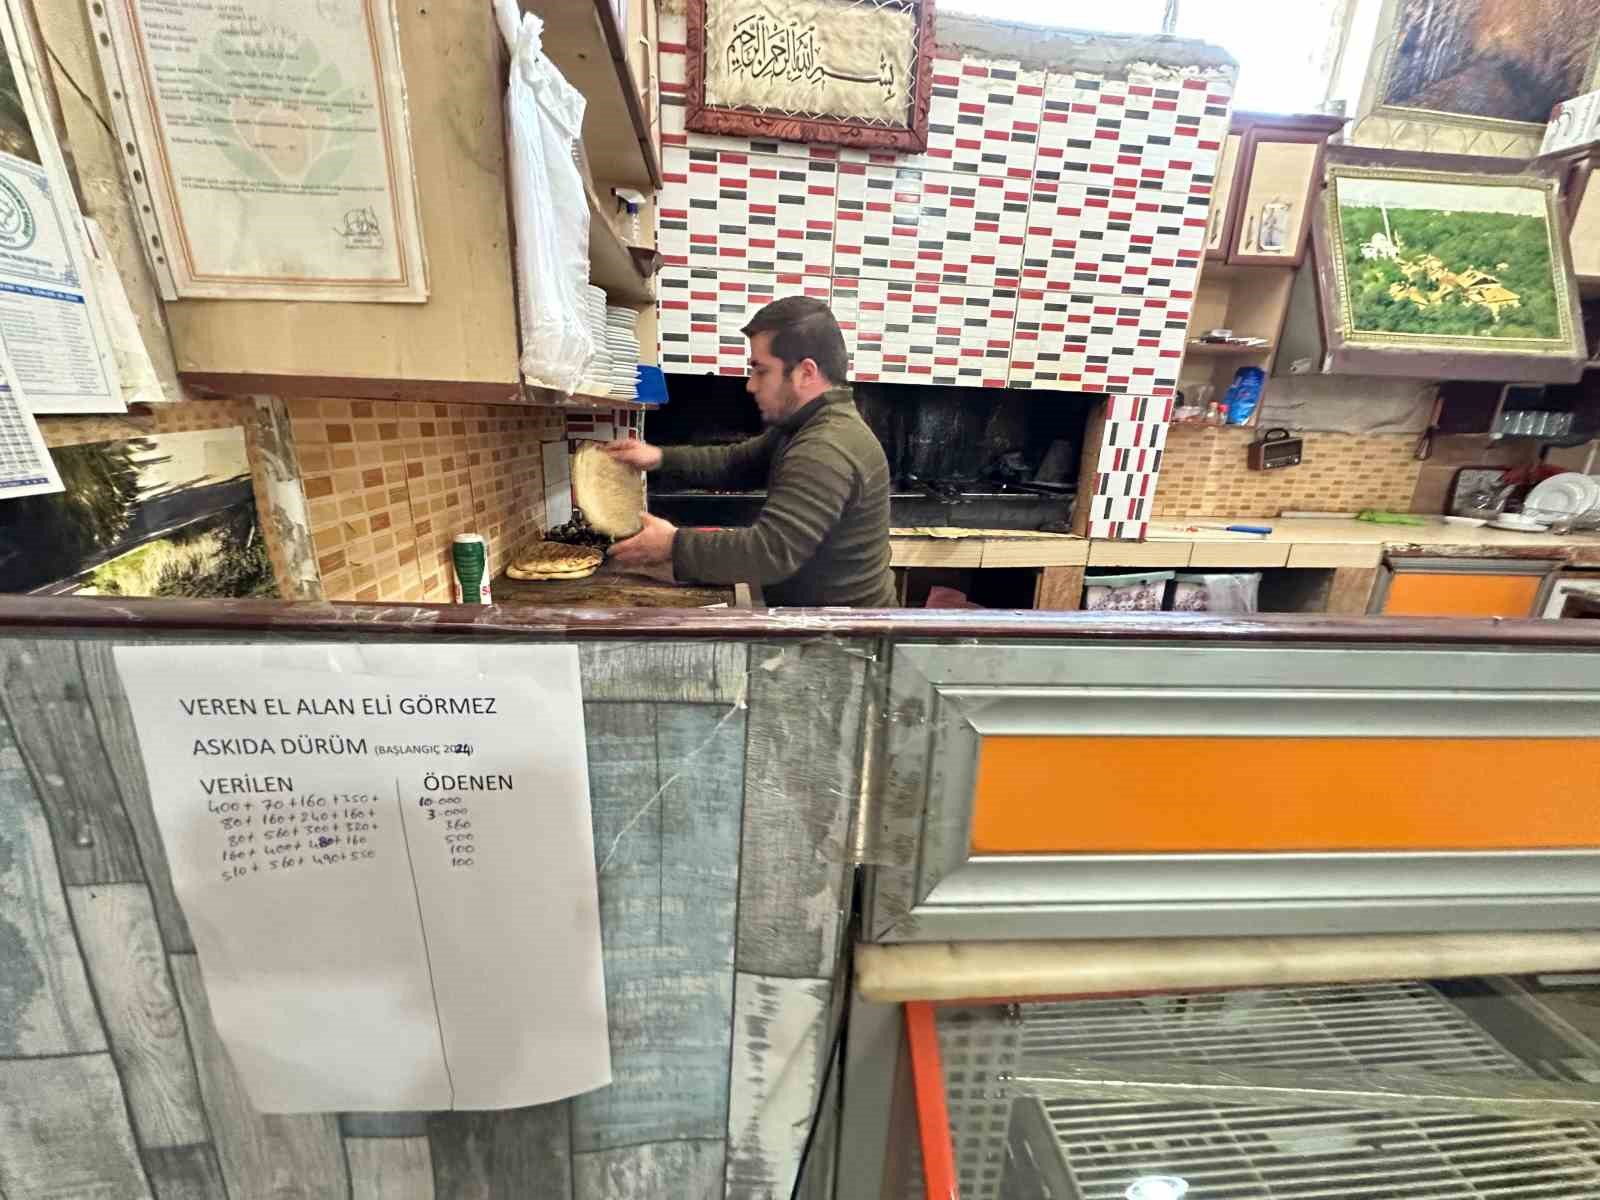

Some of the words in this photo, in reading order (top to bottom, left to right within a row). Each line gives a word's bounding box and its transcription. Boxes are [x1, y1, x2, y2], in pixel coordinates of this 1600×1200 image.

[179, 698, 257, 716] VEREN
[264, 698, 291, 716] EL
[296, 697, 355, 715] ALAN
[361, 694, 392, 715] ELİ
[399, 693, 498, 715] GÖRMEZ
[193, 738, 276, 756] ASKIDA
[280, 733, 368, 755] DÜRÜM
[200, 773, 294, 795] VERİLEN
[423, 771, 514, 791] ÖDENEN
